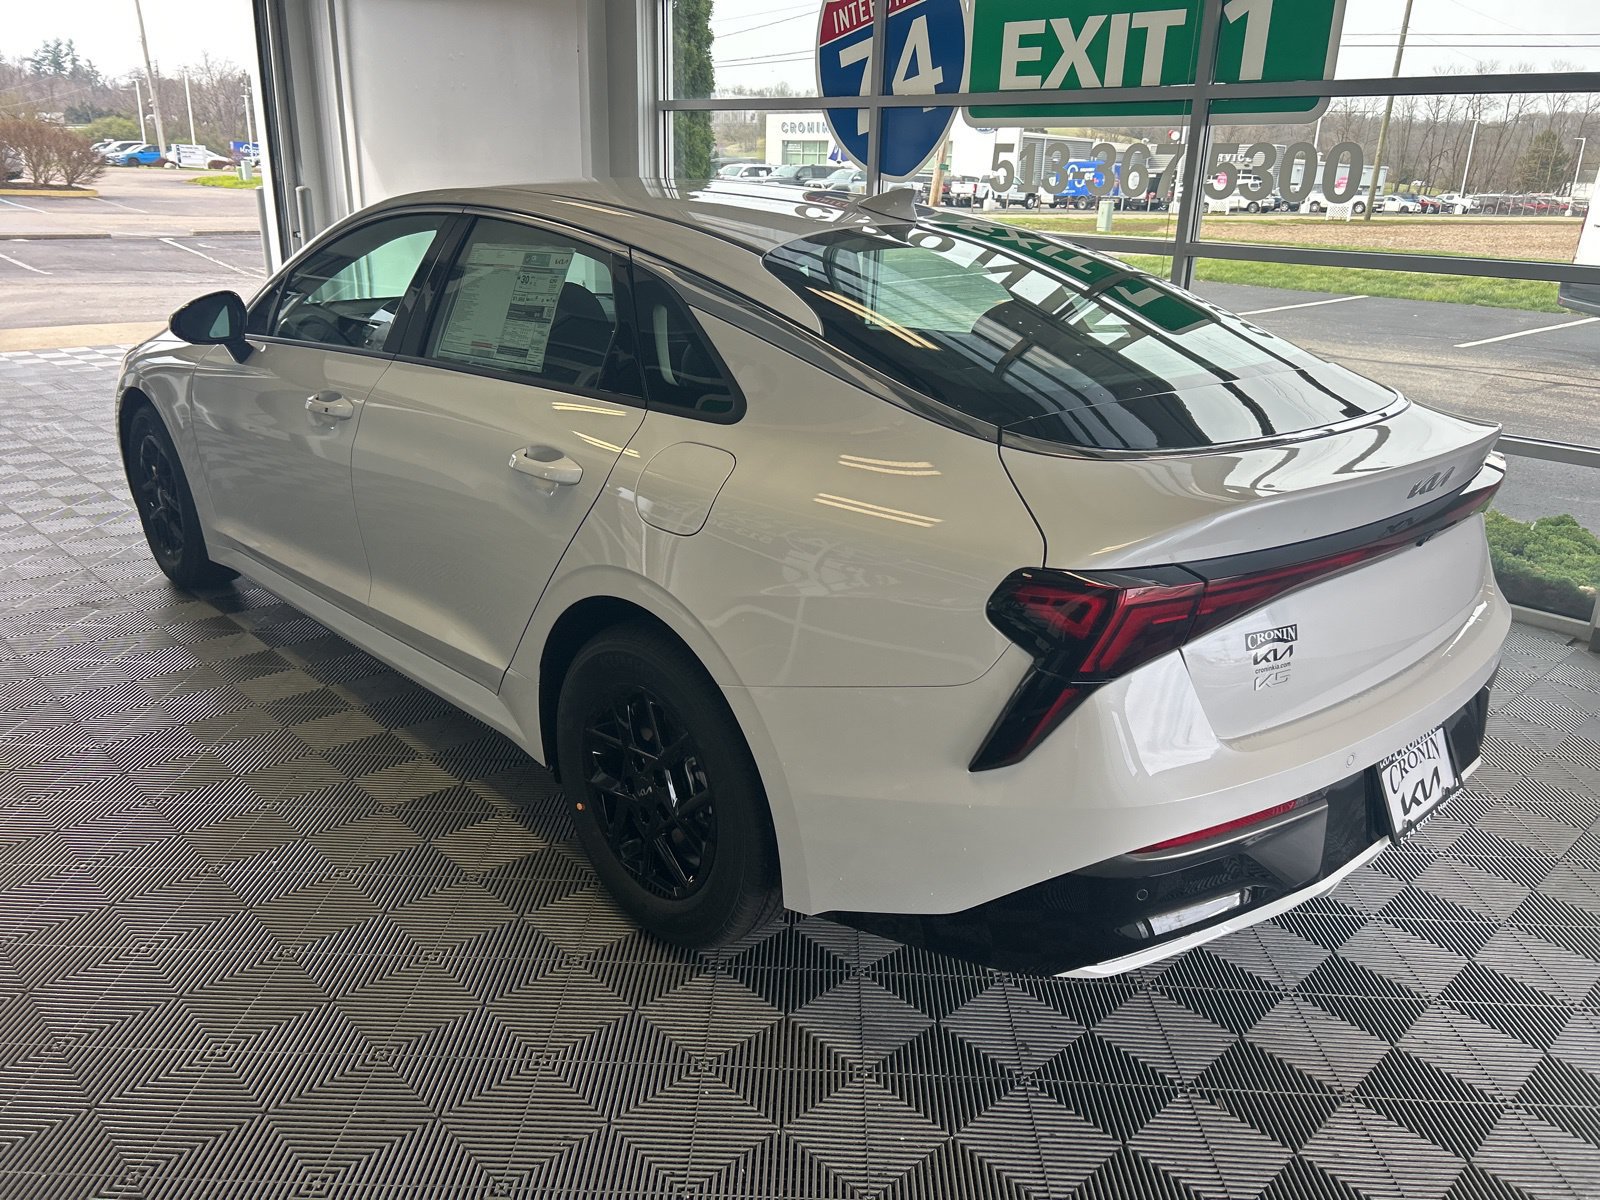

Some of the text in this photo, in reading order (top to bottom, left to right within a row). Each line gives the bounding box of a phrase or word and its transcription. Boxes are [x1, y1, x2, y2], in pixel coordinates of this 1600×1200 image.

[999, 0, 1274, 90] EXIT 1
[838, 14, 943, 136] 74
[1247, 625, 1297, 649] CRONIN
[1252, 644, 1294, 666] KIA
[1253, 668, 1292, 691] K5
[1254, 661, 1292, 674] croninkia.com
[1389, 733, 1441, 795] CRONIN
[1400, 765, 1441, 817] KIA
[1415, 813, 1432, 831] EXIT
